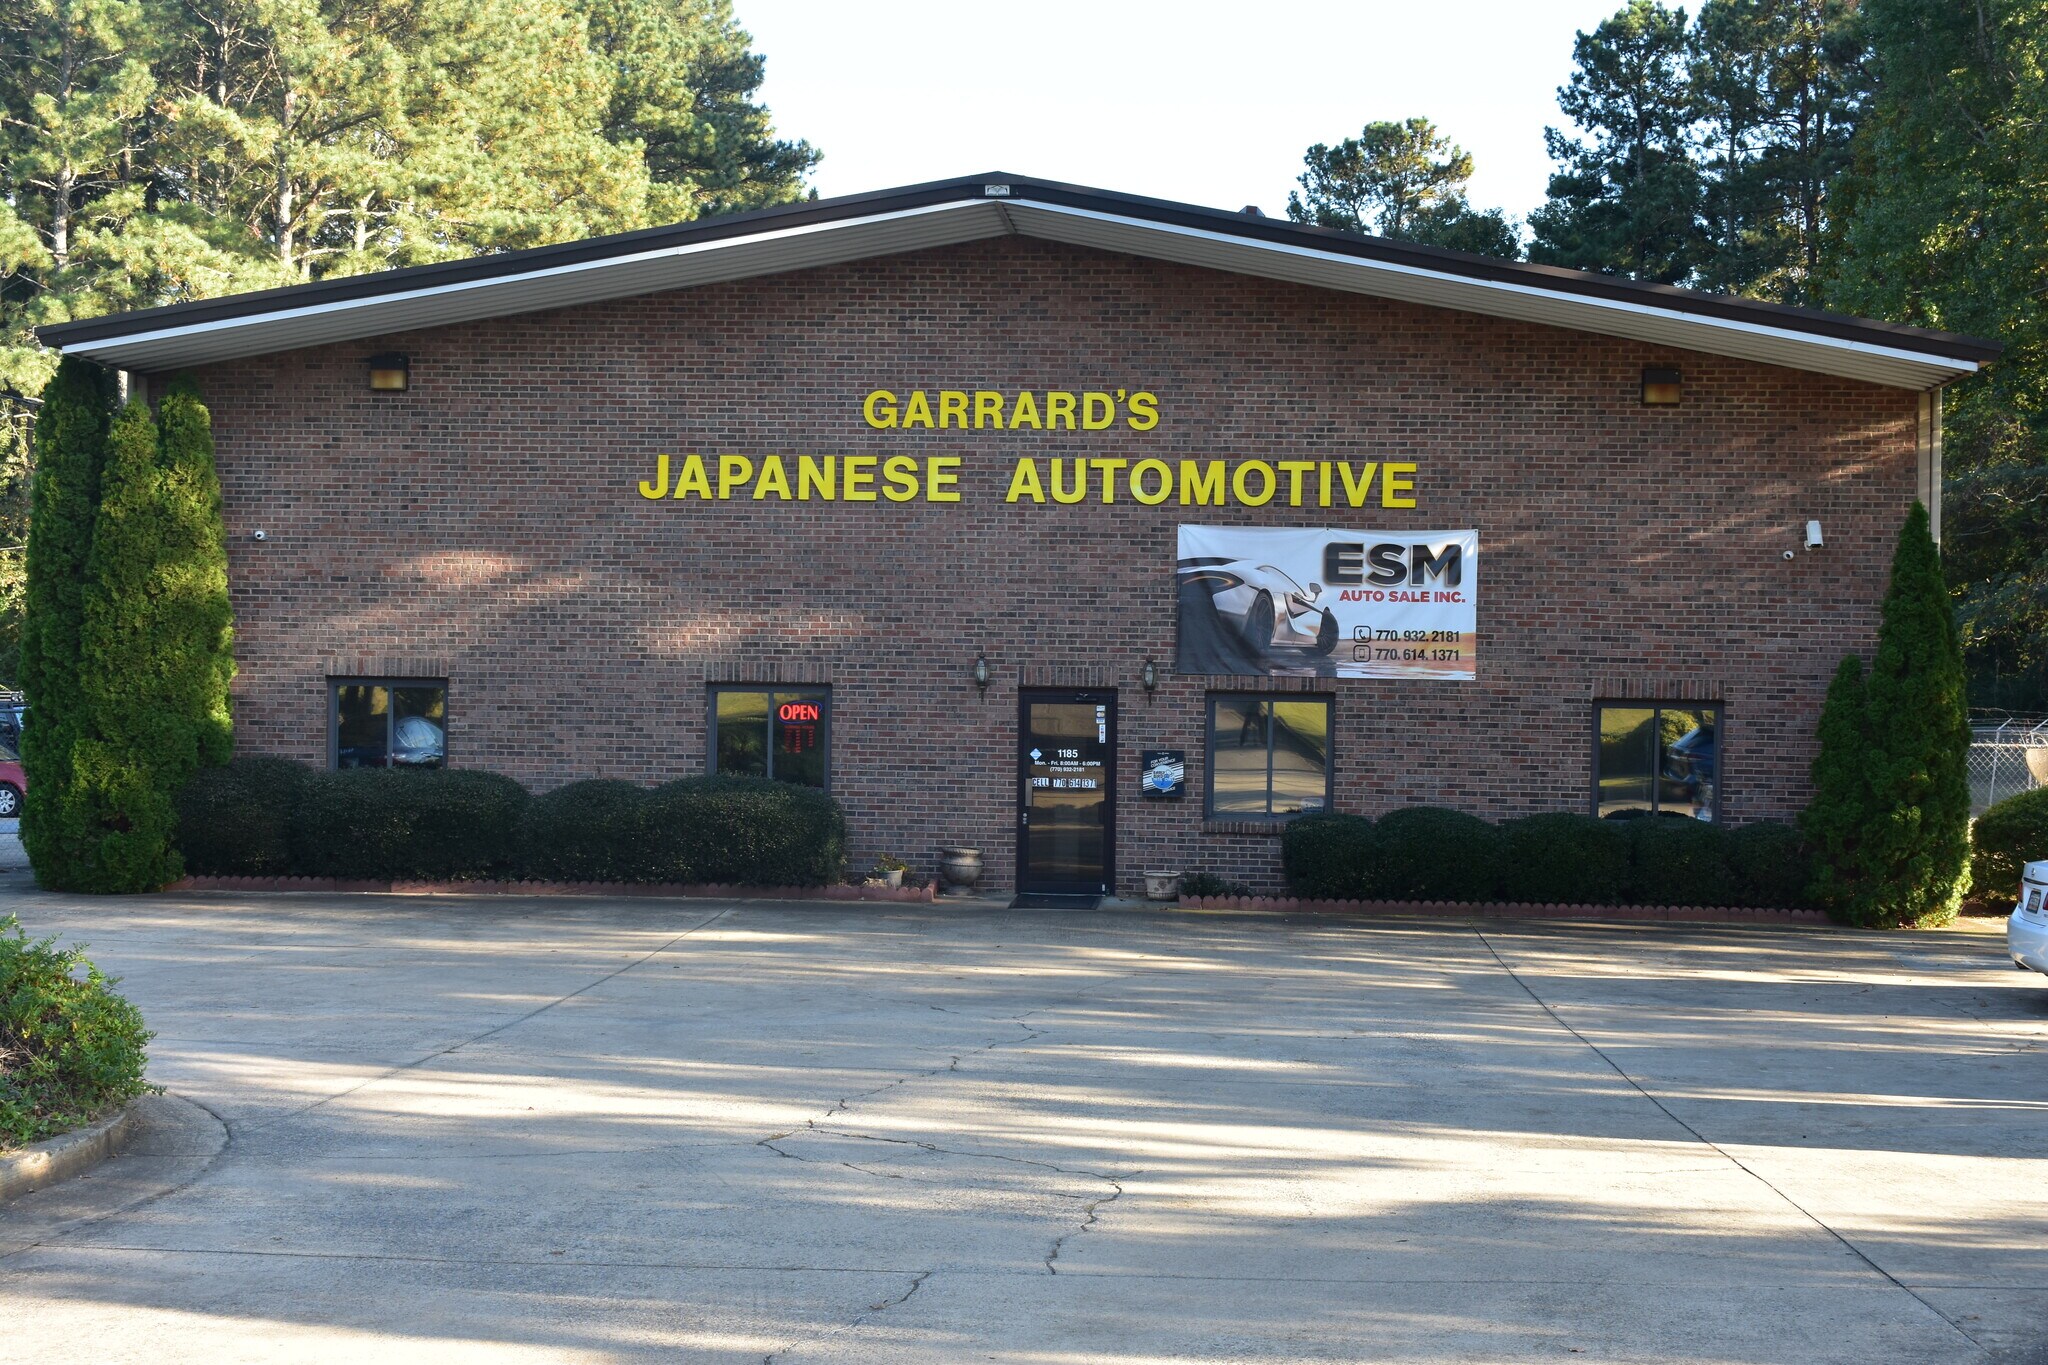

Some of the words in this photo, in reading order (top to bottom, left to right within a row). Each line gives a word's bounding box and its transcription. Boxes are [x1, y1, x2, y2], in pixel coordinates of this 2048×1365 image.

[863, 389, 1159, 431] GARRARD'S
[638, 454, 961, 502] JAPANESE
[1005, 457, 1417, 509] AUTOMOTIVE
[1324, 542, 1462, 586] ESM
[1339, 590, 1384, 602] AUTO
[1388, 590, 1430, 603] SALE
[1434, 591, 1466, 603] INC.
[780, 704, 818, 720] OPEN
[1057, 749, 1078, 758] 1185
[1032, 778, 1049, 787] CELL
